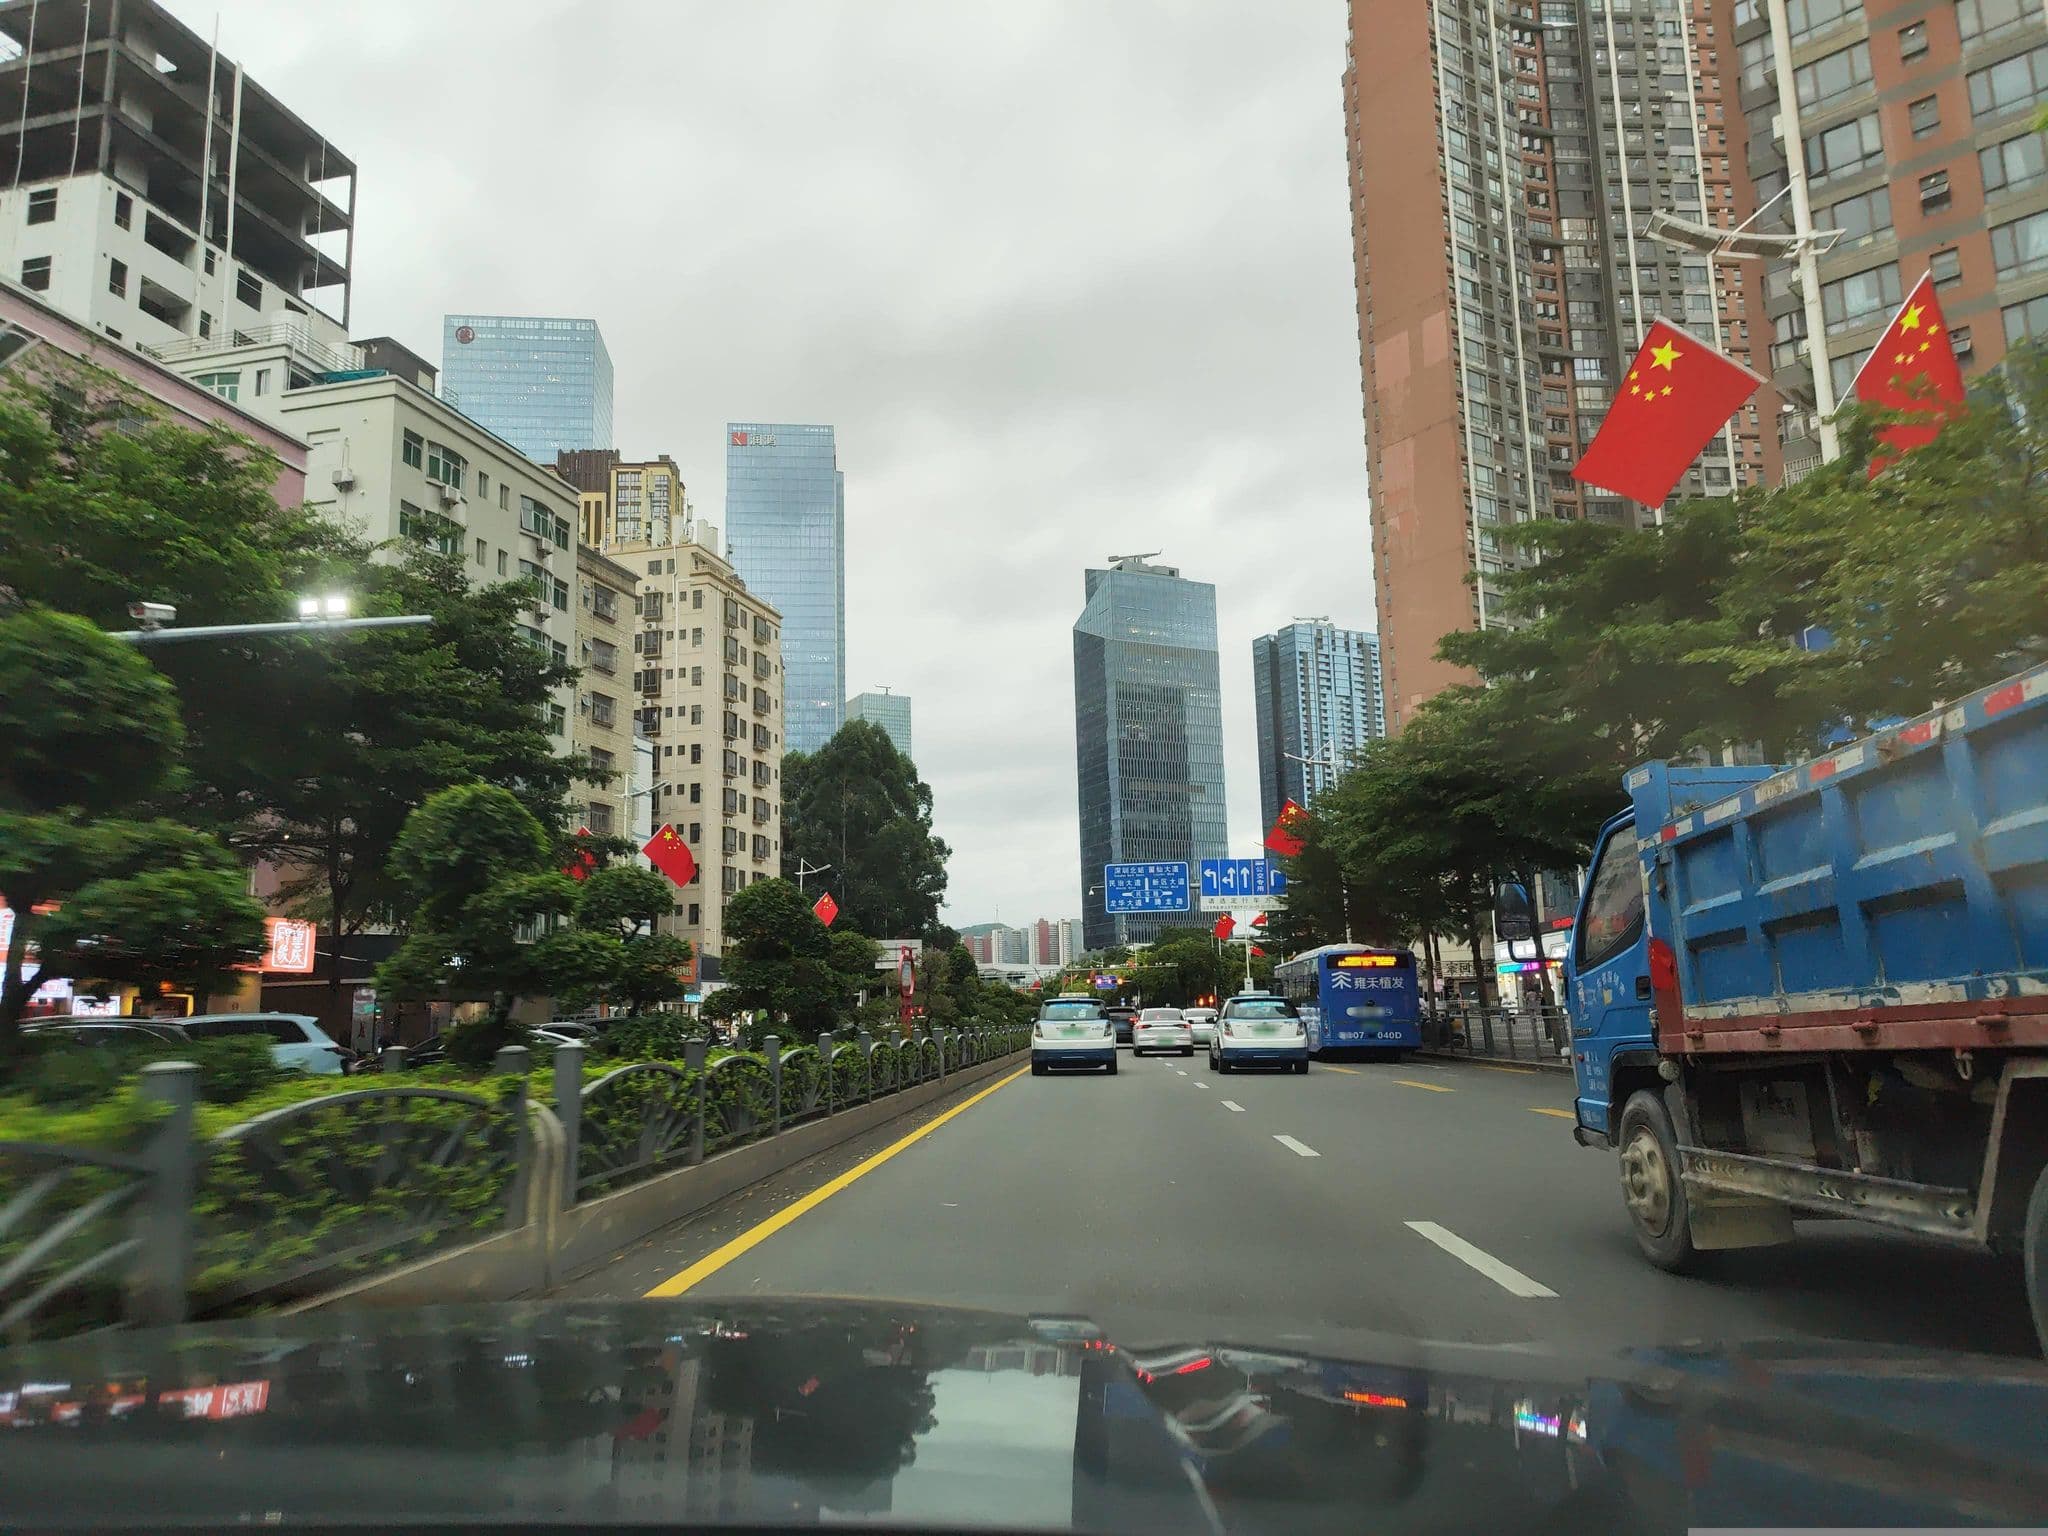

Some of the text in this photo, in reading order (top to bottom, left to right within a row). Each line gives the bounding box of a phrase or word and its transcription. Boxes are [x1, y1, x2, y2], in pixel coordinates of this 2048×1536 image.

[1255, 866, 1265, 892] 公交专用
[1110, 899, 1142, 907] 龙华大道
[1354, 976, 1405, 990] 雍禾植发
